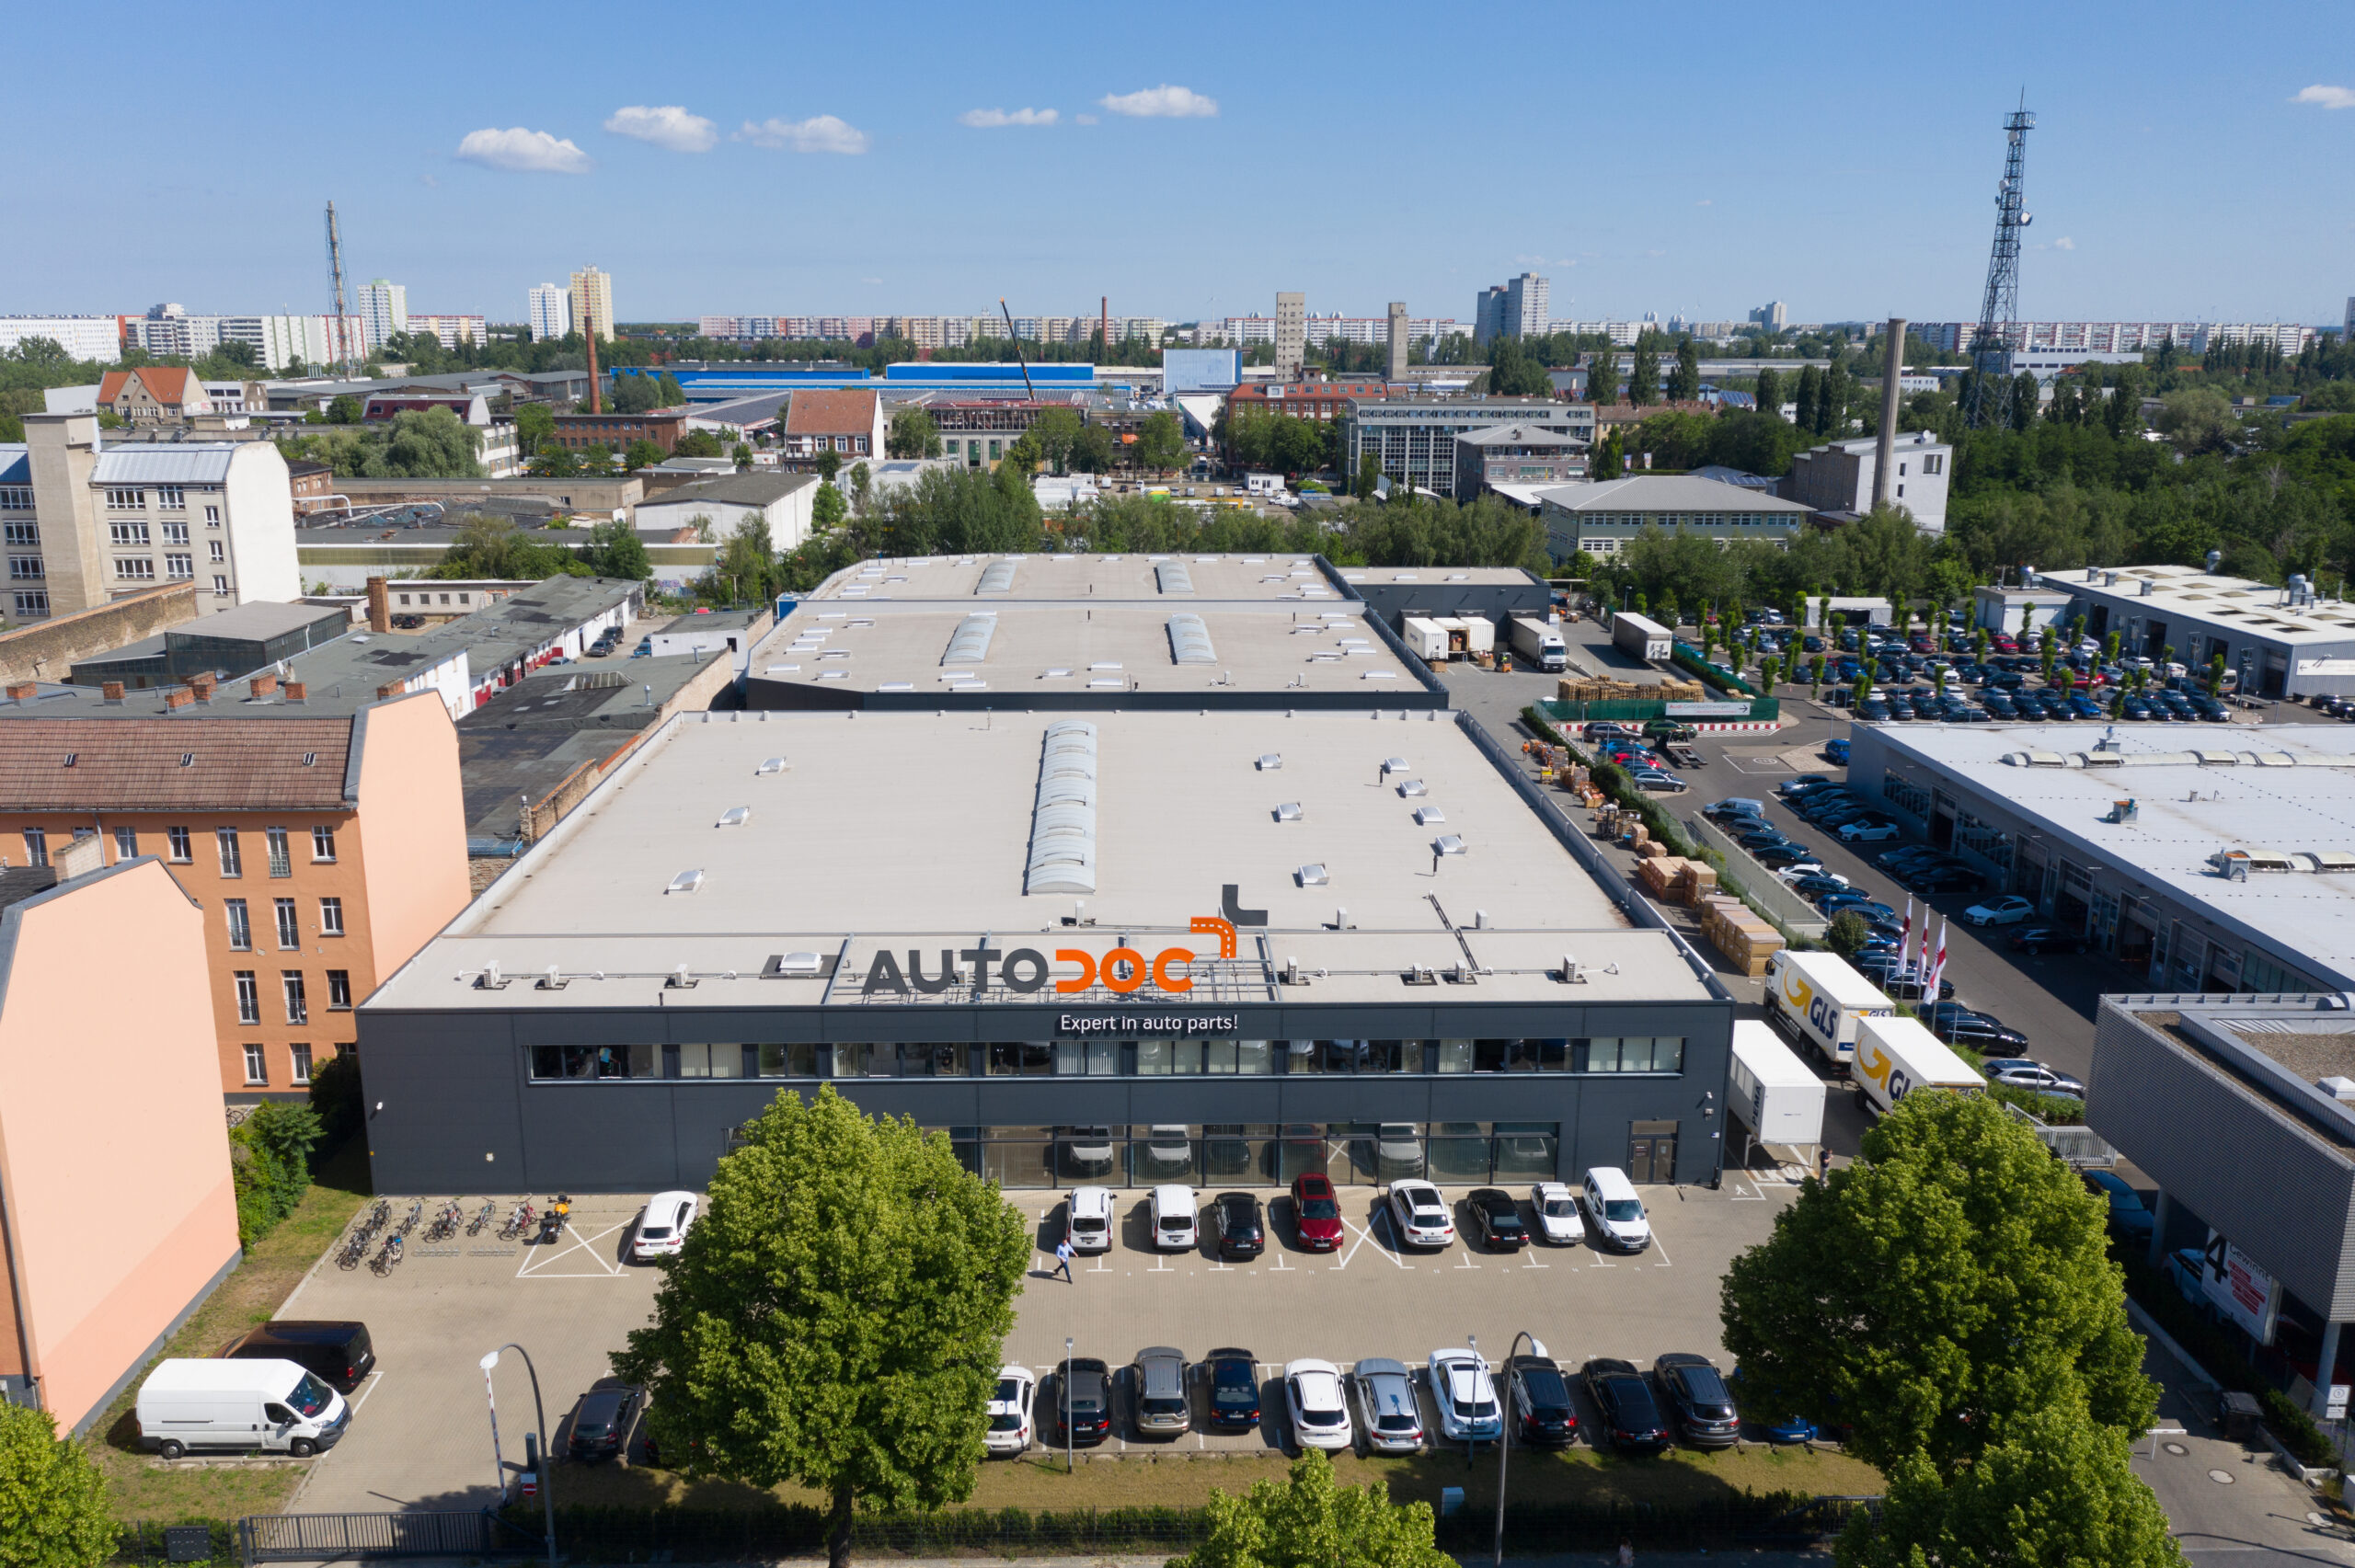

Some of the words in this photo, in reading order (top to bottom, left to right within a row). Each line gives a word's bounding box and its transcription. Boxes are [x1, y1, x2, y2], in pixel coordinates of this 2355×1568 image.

[861, 947, 1197, 994] AUTODOC
[1061, 1014, 1117, 1035] Expert
[1121, 1015, 1137, 1030] in
[1143, 1015, 1182, 1030] auto
[1188, 1013, 1238, 1034] parts!
[1809, 996, 1838, 1040] GLS
[1752, 1085, 1763, 1127] PEMA
[2205, 1234, 2229, 1285] 4
